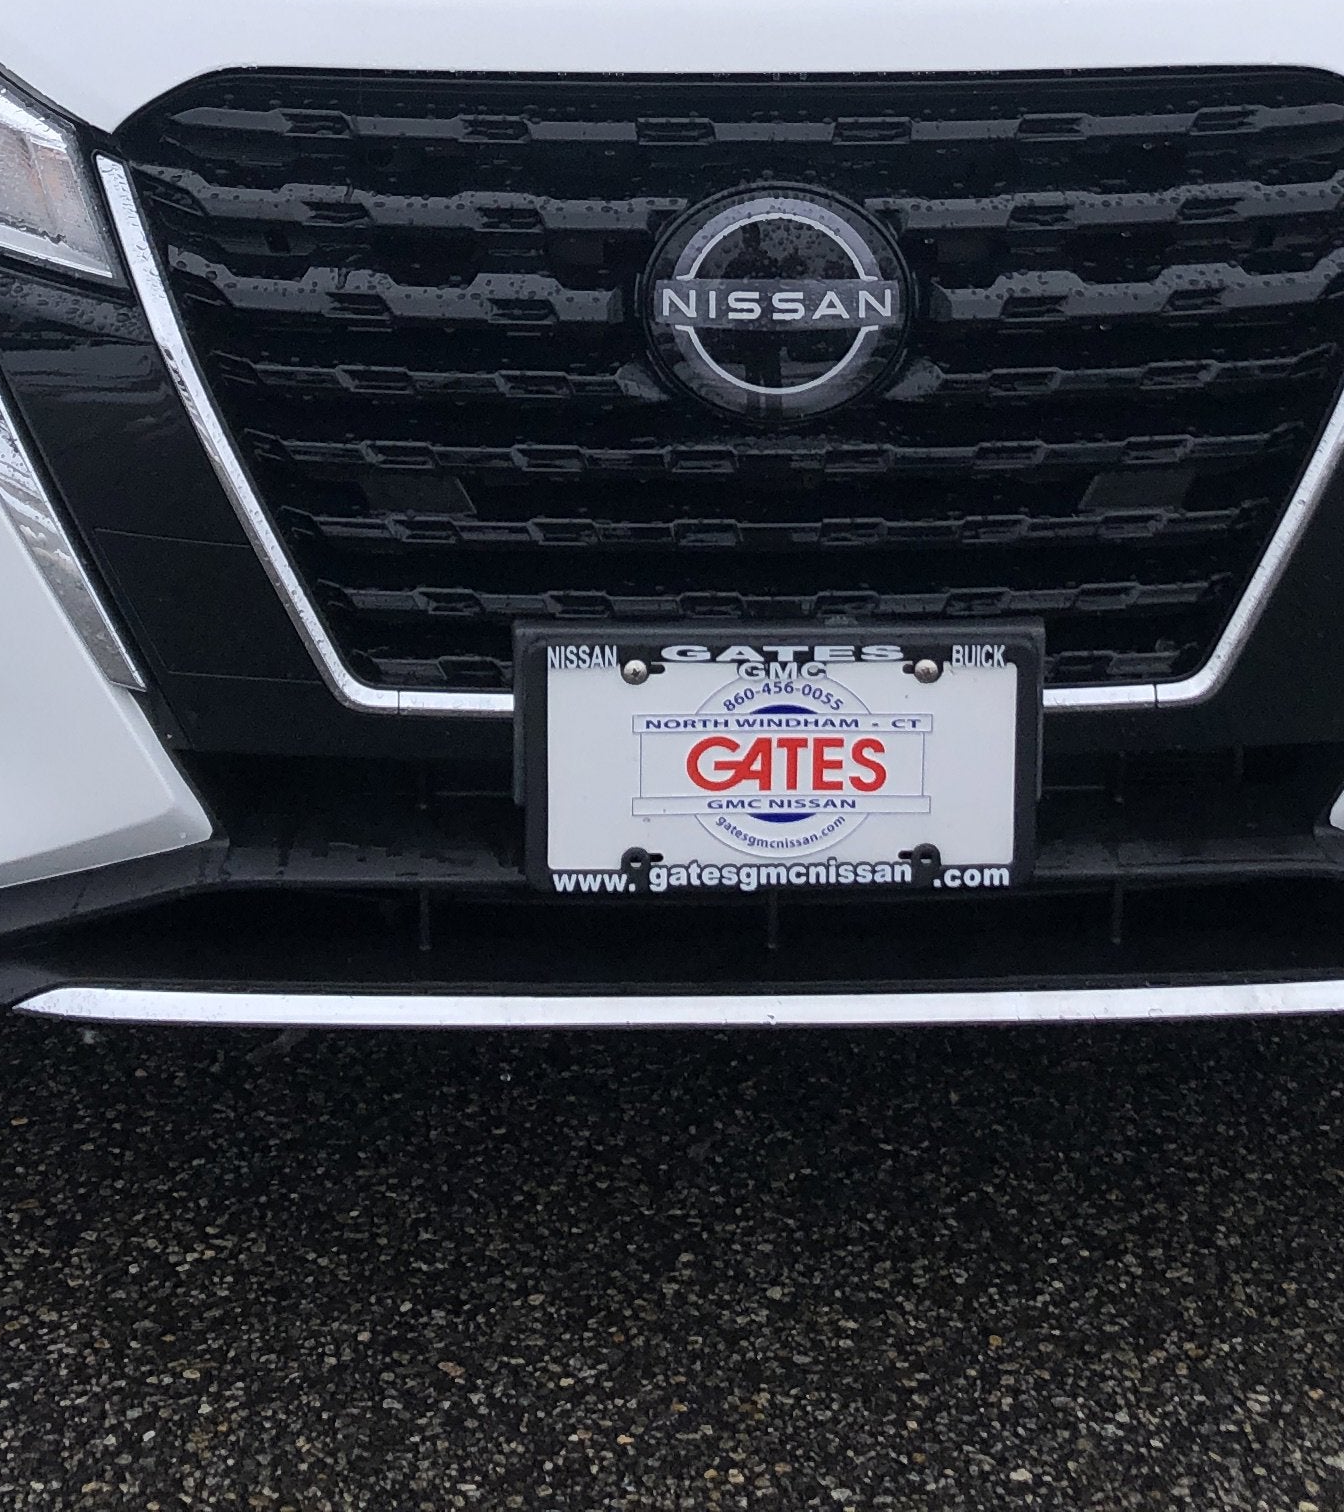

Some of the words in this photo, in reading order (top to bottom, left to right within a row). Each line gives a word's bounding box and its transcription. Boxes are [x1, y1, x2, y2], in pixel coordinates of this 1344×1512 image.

[662, 288, 893, 321] NISSAN
[547, 644, 618, 669] NISSAN
[660, 644, 905, 663] GATES
[951, 644, 1006, 668] BUICK
[737, 661, 827, 681] GMC
[722, 680, 845, 713] 860-456-0055
[644, 718, 730, 730] NORTH
[735, 718, 860, 729] WINDHAM
[890, 718, 922, 729] CT
[685, 735, 887, 792] GATES
[706, 798, 762, 810] GMC
[768, 798, 857, 810] NISSAN
[715, 814, 846, 850] gatesgmcnissan.com
[552, 872, 637, 893] www.
[649, 859, 913, 892] gatesgmcnissan
[932, 865, 1010, 888] .com
